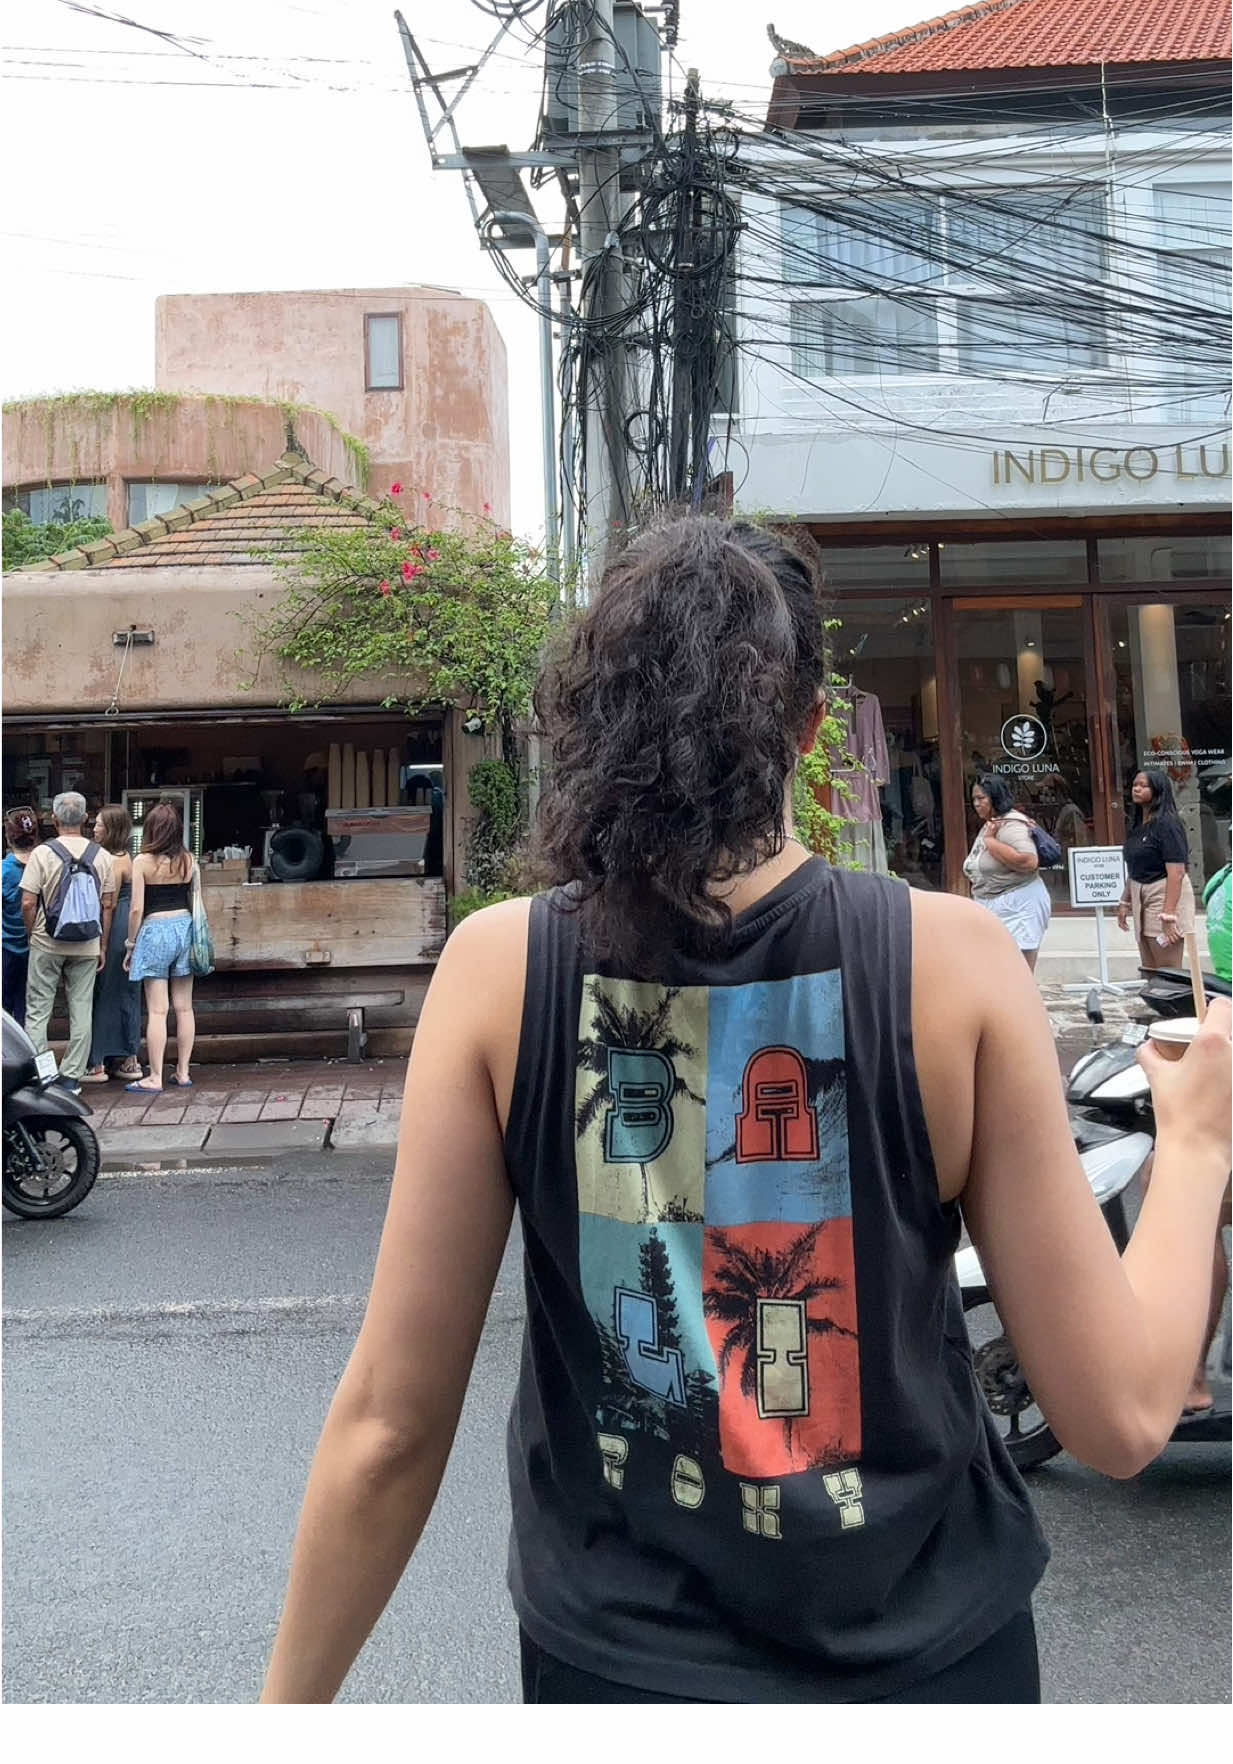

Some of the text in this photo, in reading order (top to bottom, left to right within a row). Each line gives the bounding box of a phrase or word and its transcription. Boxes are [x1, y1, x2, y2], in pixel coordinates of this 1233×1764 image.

[992, 443, 1229, 485] INDIGO LU
[1207, 747, 1225, 755] WEAR
[1197, 759, 1226, 767] CLOTHING
[992, 762, 1061, 775] INDIGO LUNA
[1077, 855, 1121, 863] INDIGO LUNA
[1079, 871, 1121, 881] CUSTOMER
[1084, 881, 1118, 890] PARKING
[1091, 890, 1112, 898] ONLY
